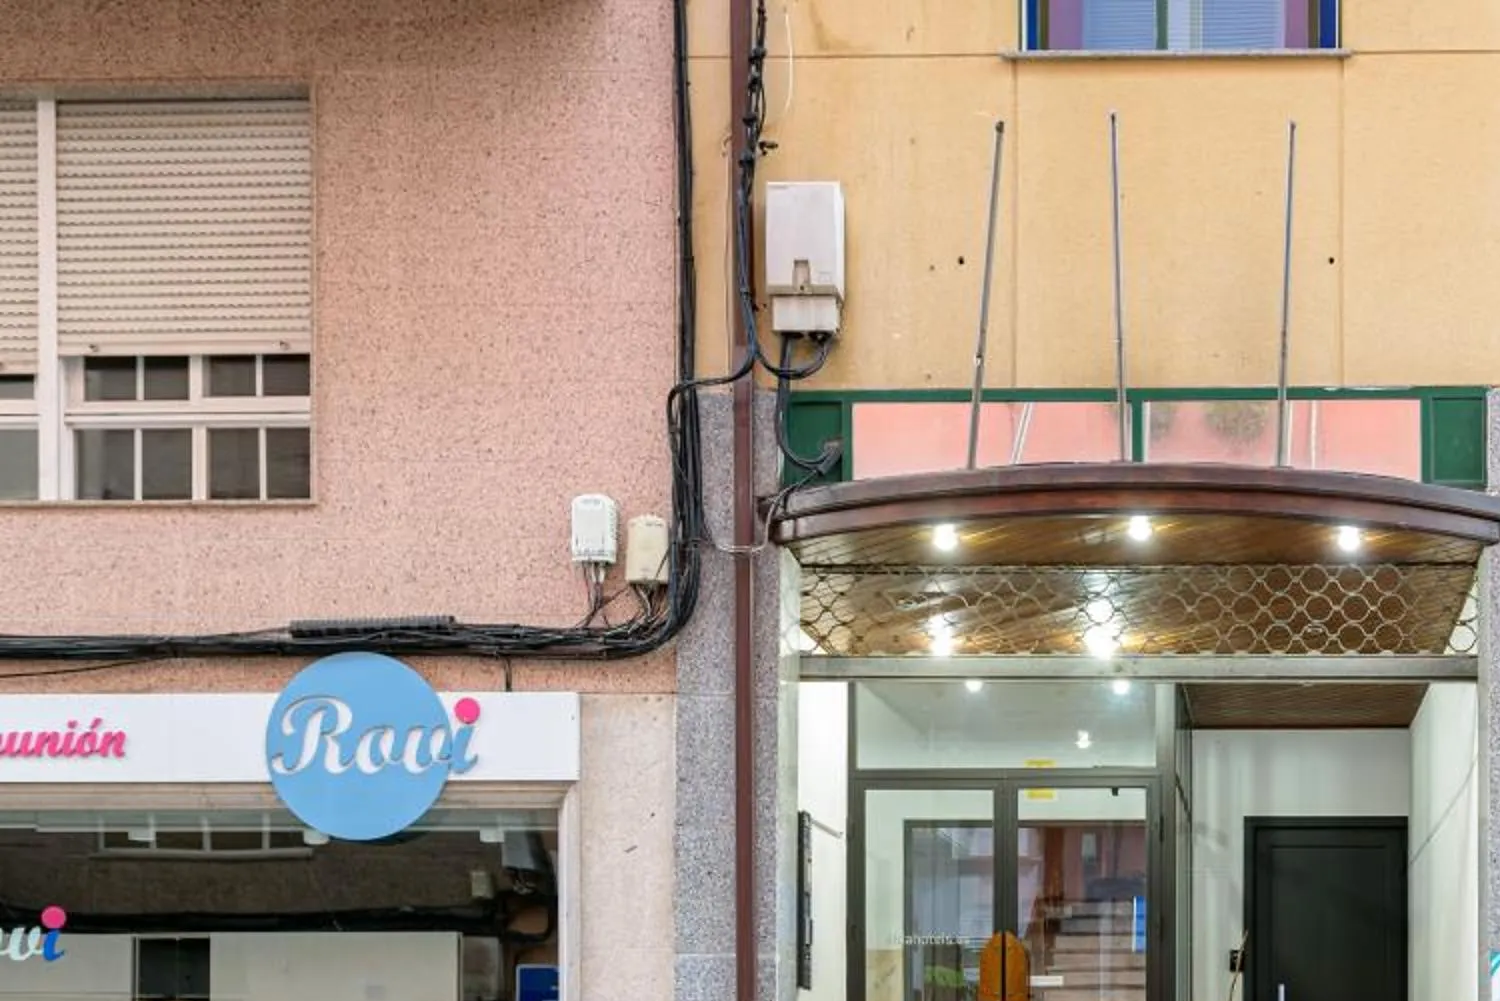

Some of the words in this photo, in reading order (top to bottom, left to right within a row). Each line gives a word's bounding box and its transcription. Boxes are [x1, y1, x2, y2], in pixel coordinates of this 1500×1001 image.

[0, 717, 126, 758] unión
[271, 695, 480, 774] Rovi
[0, 905, 66, 961] vi
